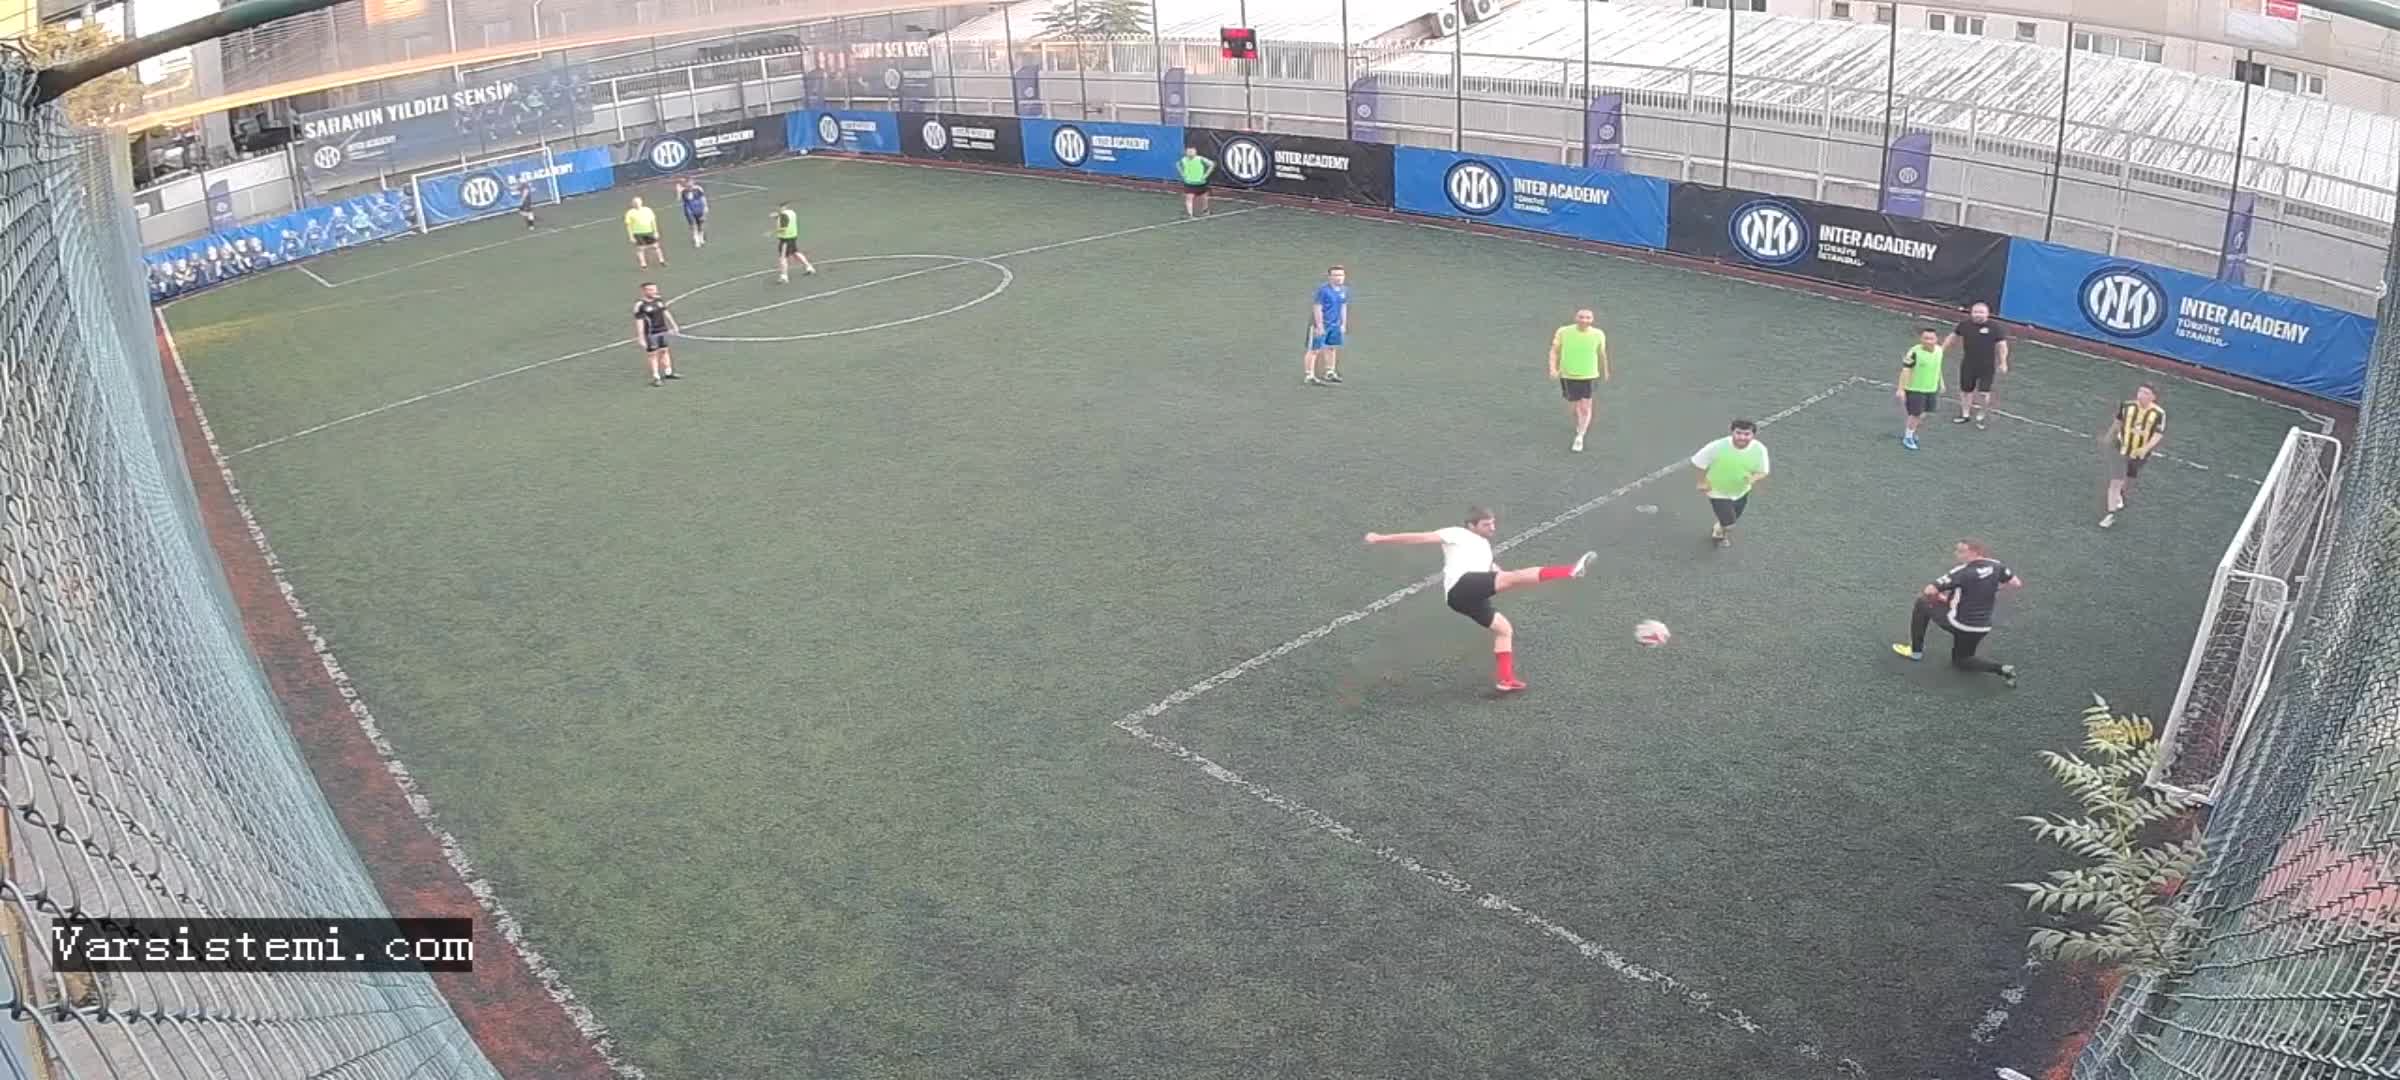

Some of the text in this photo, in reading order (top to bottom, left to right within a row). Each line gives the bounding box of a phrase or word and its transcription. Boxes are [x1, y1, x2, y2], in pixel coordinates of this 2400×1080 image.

[304, 106, 384, 139] SAHANIN
[386, 94, 448, 122] YILDIZI
[1302, 153, 1350, 170] ACADEMY
[1513, 177, 1610, 205] INTER ACADEMY
[1819, 224, 1938, 262] INTER ACADEMY
[2179, 296, 2310, 345] INTER ACADEMY
